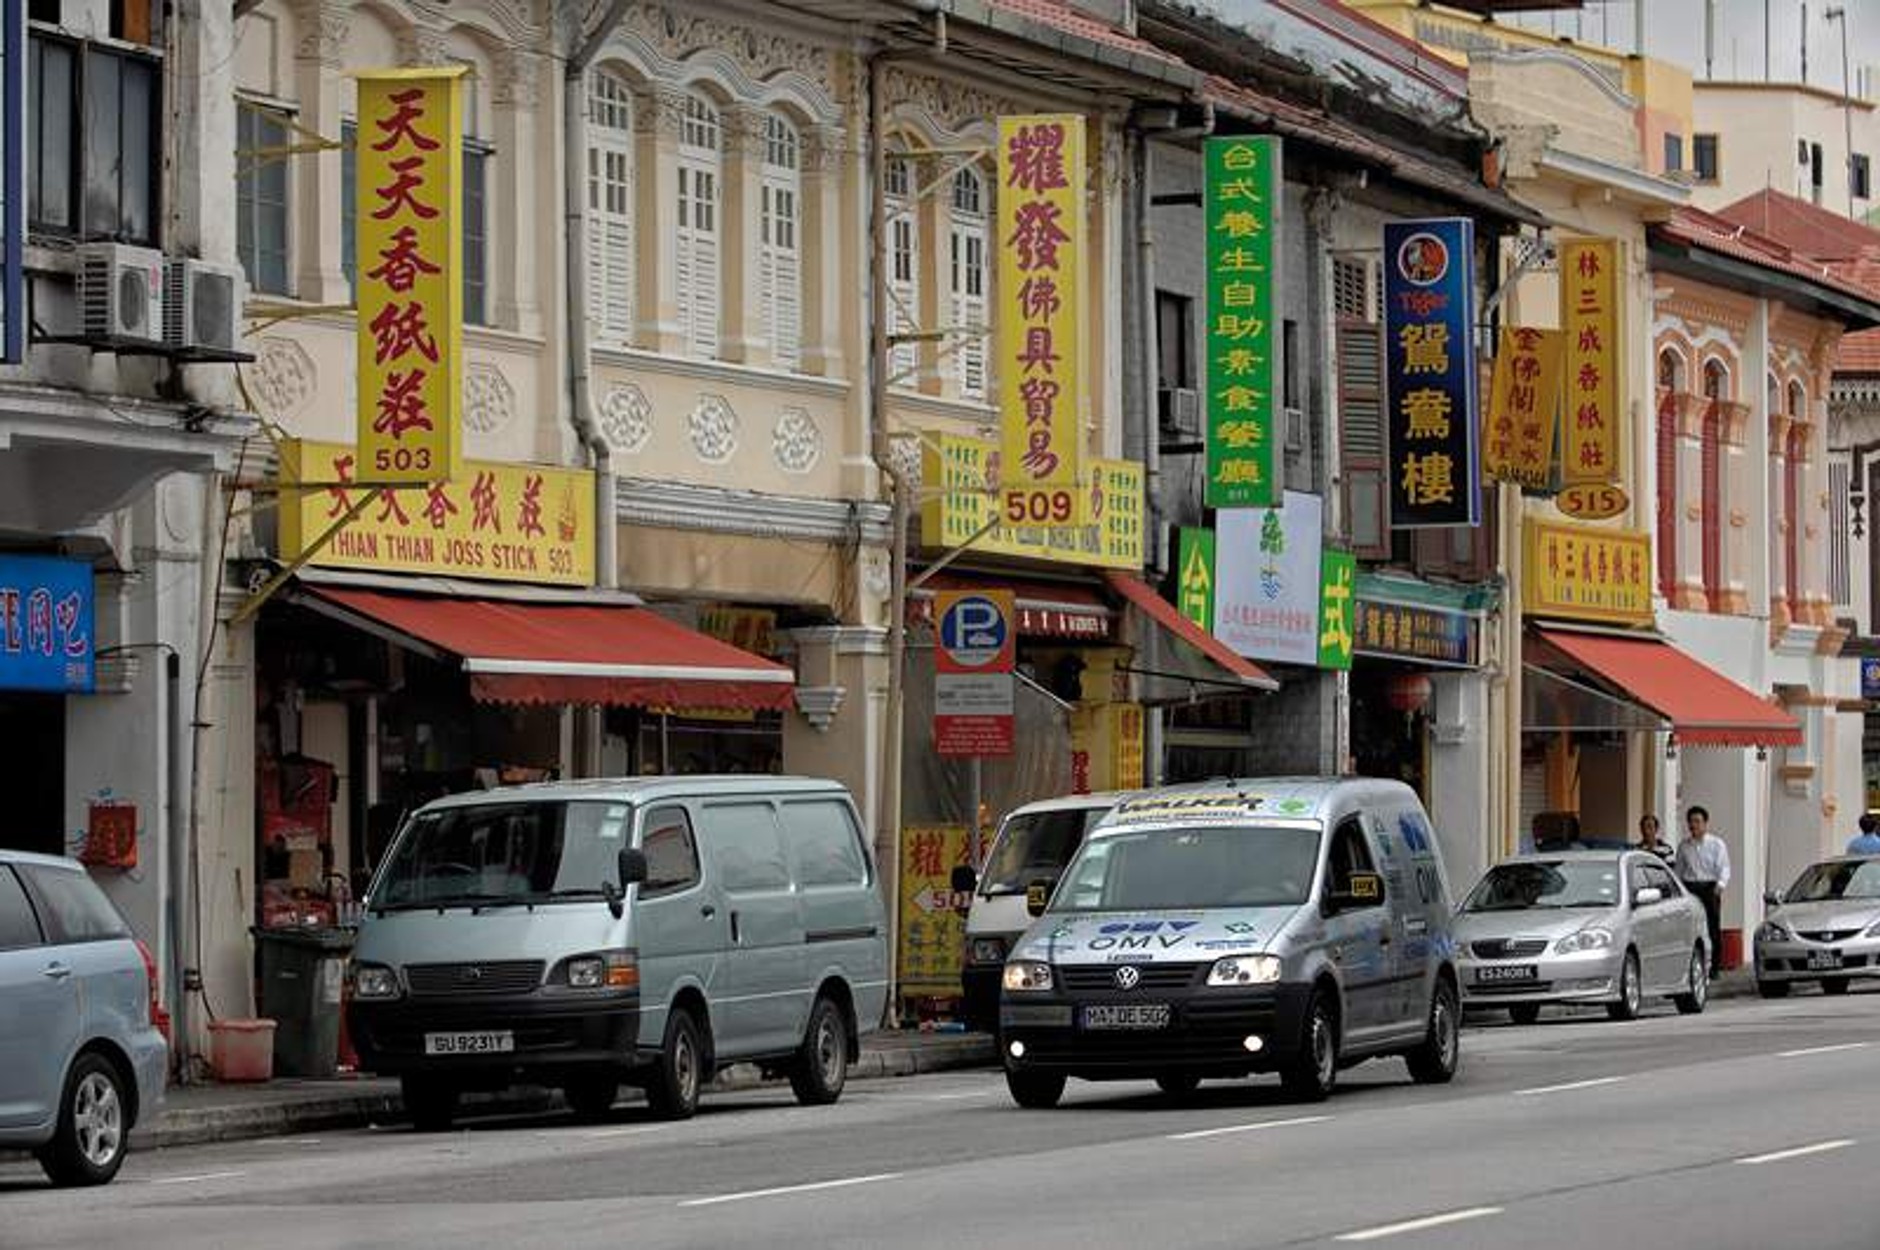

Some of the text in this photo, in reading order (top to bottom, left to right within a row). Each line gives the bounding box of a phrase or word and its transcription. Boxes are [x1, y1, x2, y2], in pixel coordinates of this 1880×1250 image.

[375, 449, 431, 471] 503
[1007, 490, 1071, 522] 509
[1567, 491, 1615, 512] 515
[331, 532, 572, 574] THIAN THIAN JOSS STICK 503
[1088, 935, 1187, 950] OMV
